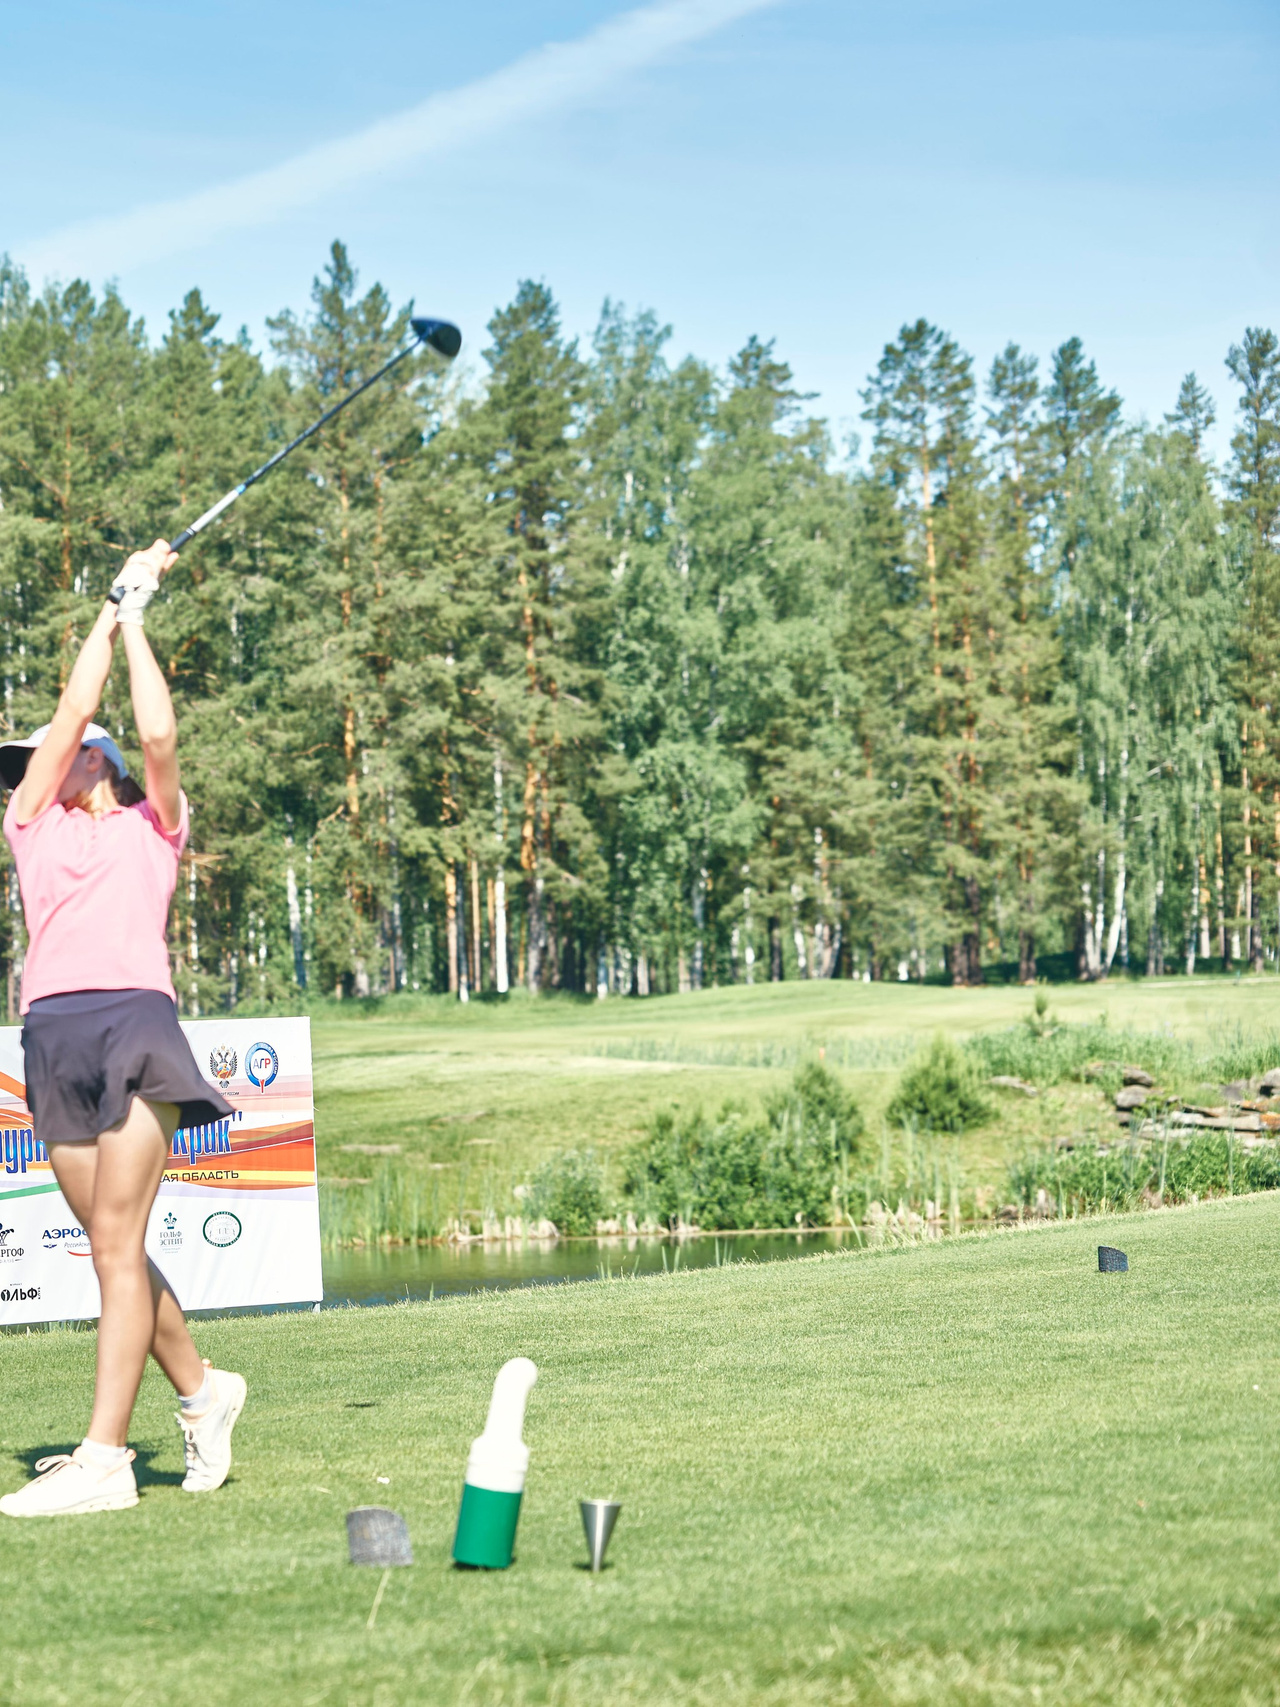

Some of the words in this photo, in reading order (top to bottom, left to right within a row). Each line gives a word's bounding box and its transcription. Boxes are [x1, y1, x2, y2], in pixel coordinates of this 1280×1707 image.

[253, 1058, 271, 1069] АГР
[160, 1173, 179, 1183] АЯ
[182, 1170, 239, 1182] ОБЛАСТЬ
[42, 1227, 89, 1240] АЭРО
[159, 1230, 183, 1239] ГОЛЬФ
[159, 1237, 184, 1246] ЭСТЕЙТ
